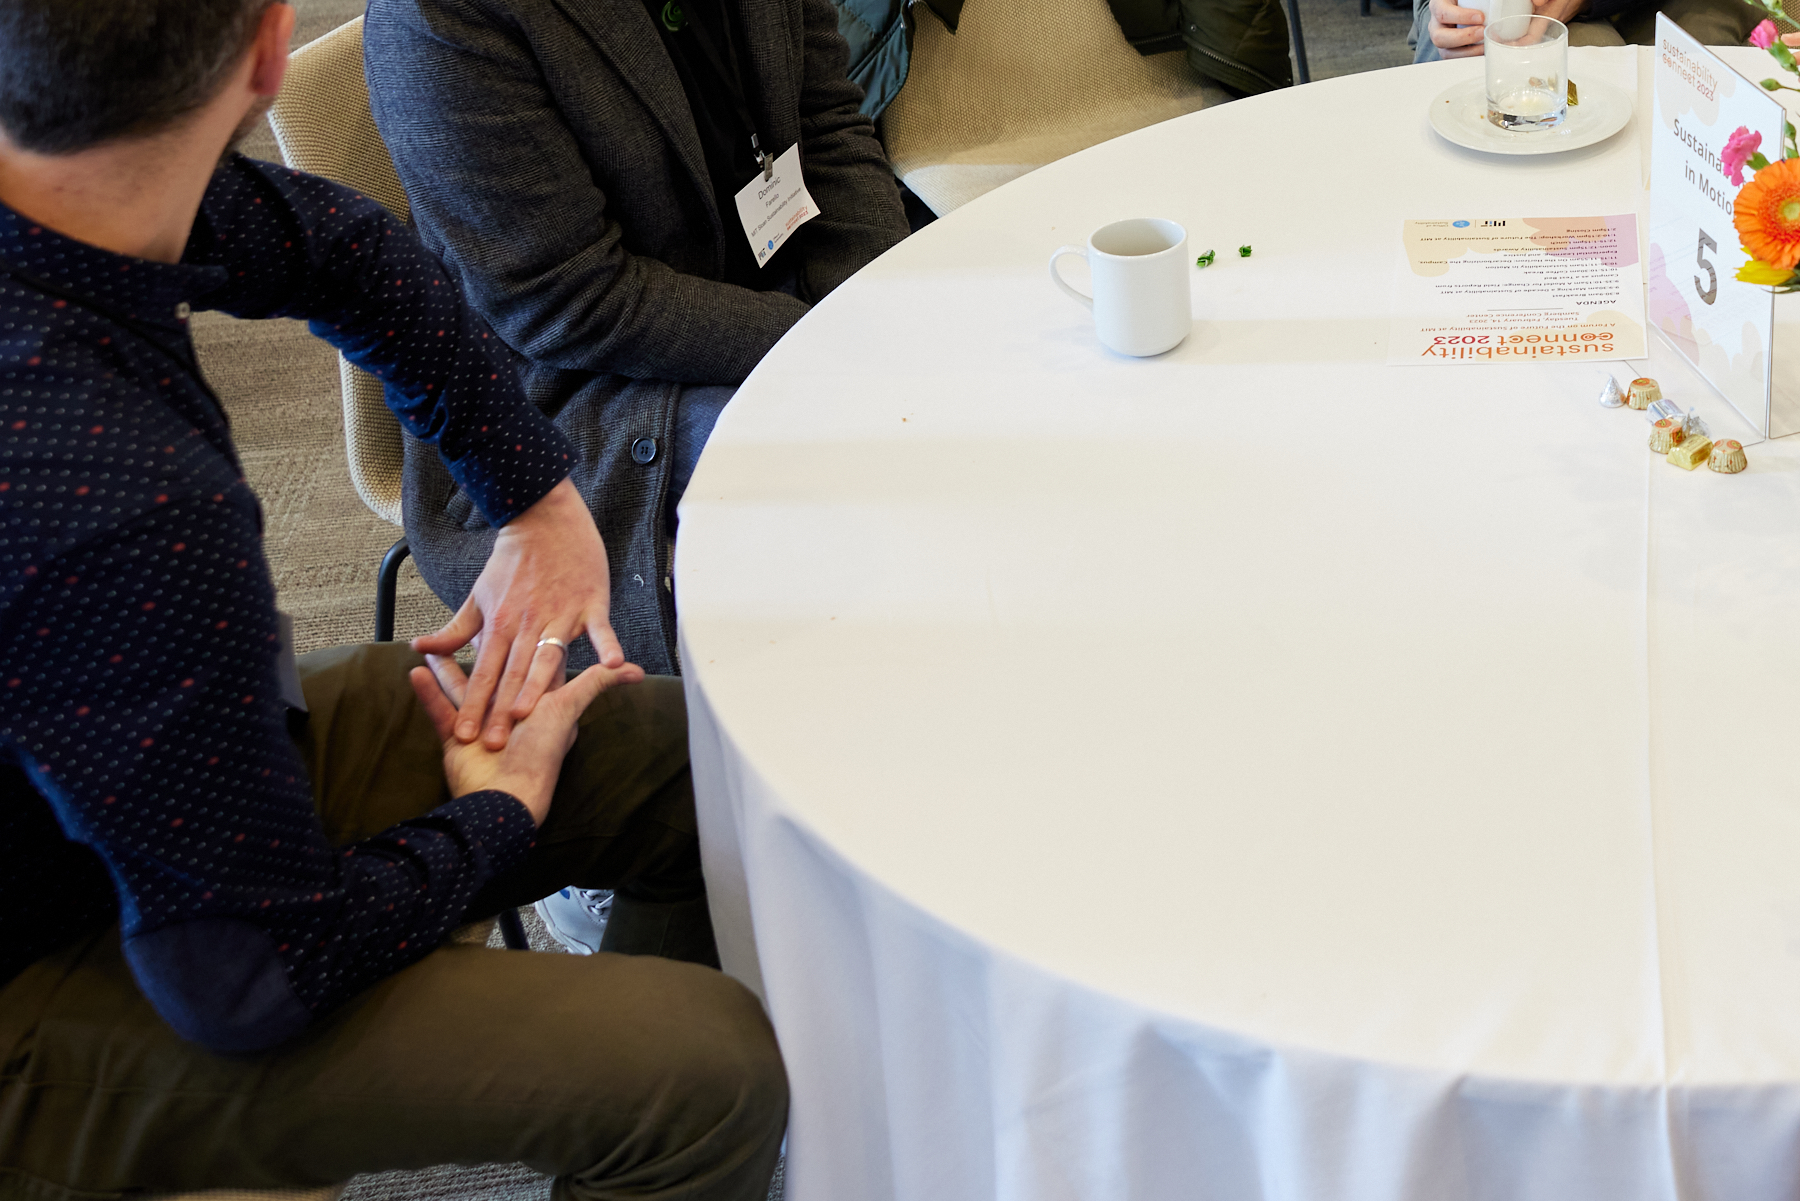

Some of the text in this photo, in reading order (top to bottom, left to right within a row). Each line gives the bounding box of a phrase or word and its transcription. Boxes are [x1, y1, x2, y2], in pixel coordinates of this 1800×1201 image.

[1662, 53, 1714, 102] connect 2023
[1663, 39, 1718, 92] sustainability
[758, 176, 781, 200] Dominic
[1685, 160, 1733, 216] in Motio
[1694, 227, 1718, 306] 5
[1421, 343, 1614, 359] sustainability
[1433, 332, 1614, 346] connect 2023
